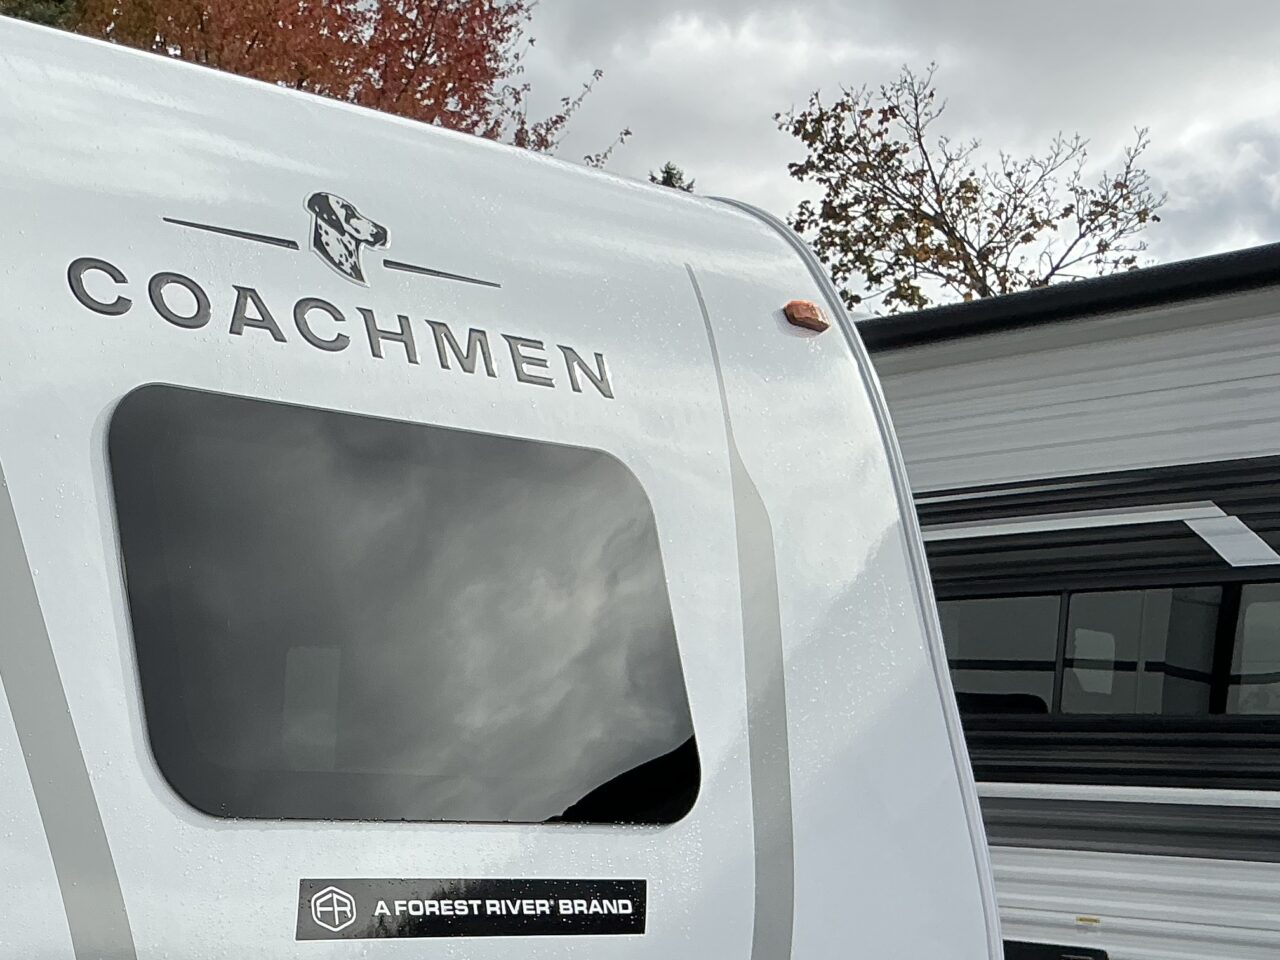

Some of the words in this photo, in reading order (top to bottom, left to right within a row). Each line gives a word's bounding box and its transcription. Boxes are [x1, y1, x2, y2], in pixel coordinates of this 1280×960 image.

[67, 256, 615, 400] COACHMEN
[374, 900, 391, 916] A
[394, 899, 482, 916] FOREST
[558, 899, 634, 915] BRAND
